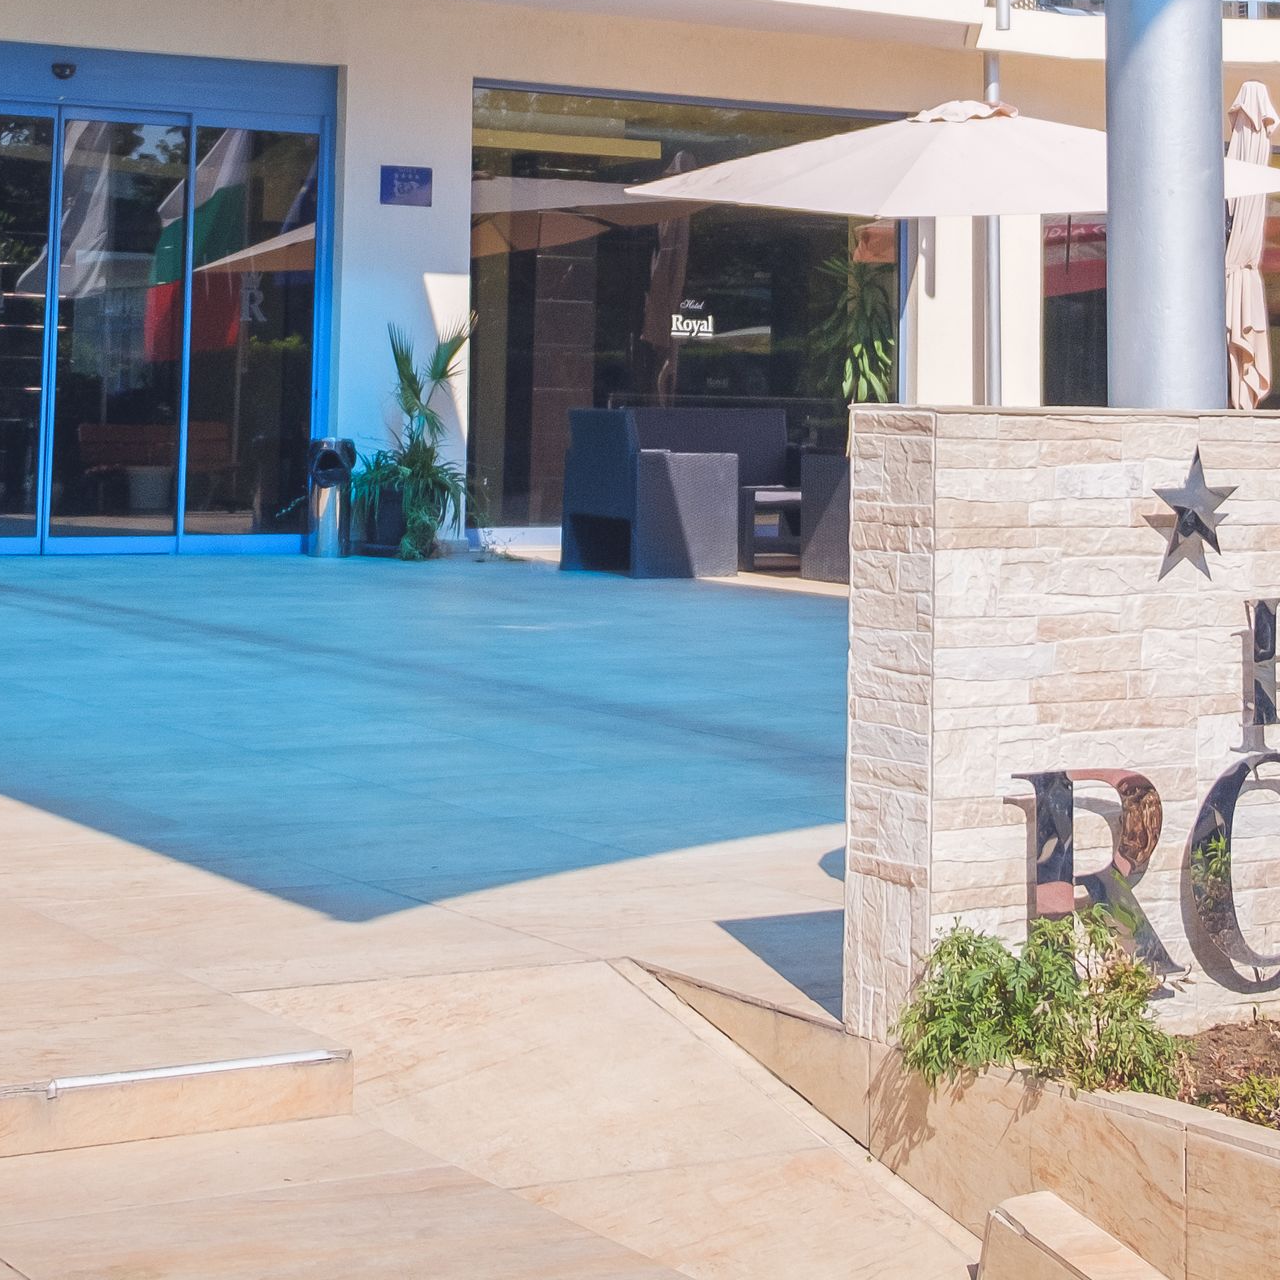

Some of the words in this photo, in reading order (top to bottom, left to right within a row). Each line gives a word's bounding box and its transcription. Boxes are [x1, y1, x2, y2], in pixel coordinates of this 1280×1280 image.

[239, 289, 268, 322] R
[679, 299, 705, 310] Hotel
[671, 314, 713, 336] Royal
